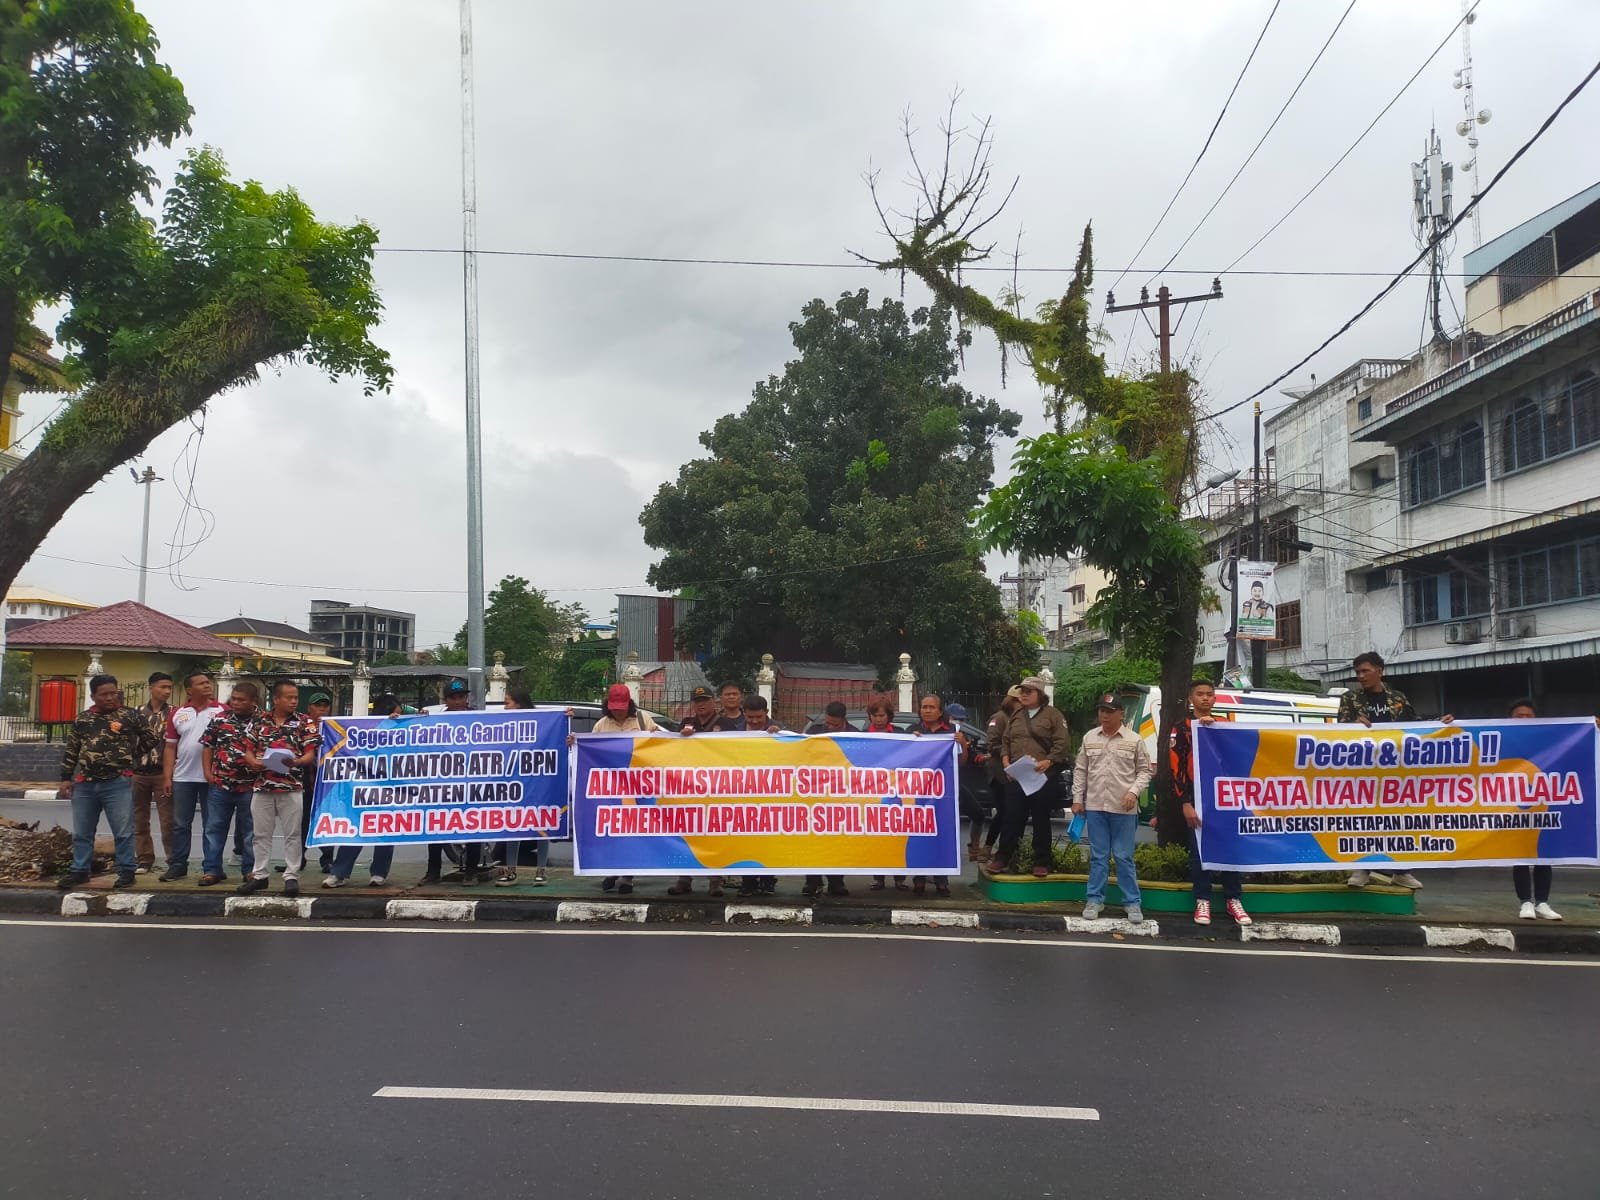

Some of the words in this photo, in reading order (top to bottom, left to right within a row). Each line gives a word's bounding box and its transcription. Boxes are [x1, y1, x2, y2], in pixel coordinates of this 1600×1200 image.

[347, 728, 406, 749] Segera
[410, 724, 452, 745] Tarik
[455, 726, 468, 744] &
[471, 722, 516, 743] Ganti
[519, 721, 536, 742] !!!
[1297, 737, 1374, 767] Pecat
[1379, 741, 1398, 766] &
[1403, 735, 1470, 765] Ganti
[1481, 734, 1499, 763] !!
[323, 756, 388, 781] KEPALA
[391, 753, 465, 779] KANTOR
[468, 752, 503, 776] ATR
[507, 751, 517, 775] /
[520, 751, 557, 774] BPN
[353, 784, 464, 806] KABUPATEN
[469, 782, 522, 802] KARO
[588, 769, 661, 796] ALIANSI
[665, 768, 793, 795] MASYARAKAT
[798, 768, 846, 795] SIPIL
[851, 769, 894, 795] KAB.
[897, 770, 943, 797] KARO
[1217, 780, 1308, 807] EFRATA
[1316, 779, 1376, 806] IVAN
[1382, 777, 1474, 804] BAPTIS
[1481, 775, 1580, 803] MILALA
[316, 815, 355, 836] An.
[362, 812, 421, 834] ERNI
[428, 808, 557, 832] HASIBUAN
[598, 806, 703, 834] PEMERHATI
[707, 806, 809, 833] APARATUR
[813, 806, 862, 833] SIPIL
[866, 806, 936, 834] NEGARA
[1239, 817, 1284, 834] KEPALA
[1285, 816, 1324, 832] SEKSI
[1327, 815, 1400, 832] PENETAPAN
[1404, 814, 1431, 830] DAN
[1434, 813, 1530, 830] PENDAFTARAN
[1533, 812, 1561, 829] HAK
[1339, 838, 1353, 853] DI
[1357, 837, 1384, 852] BPN
[1387, 836, 1419, 852] KAB.
[1421, 836, 1455, 851] Karo
